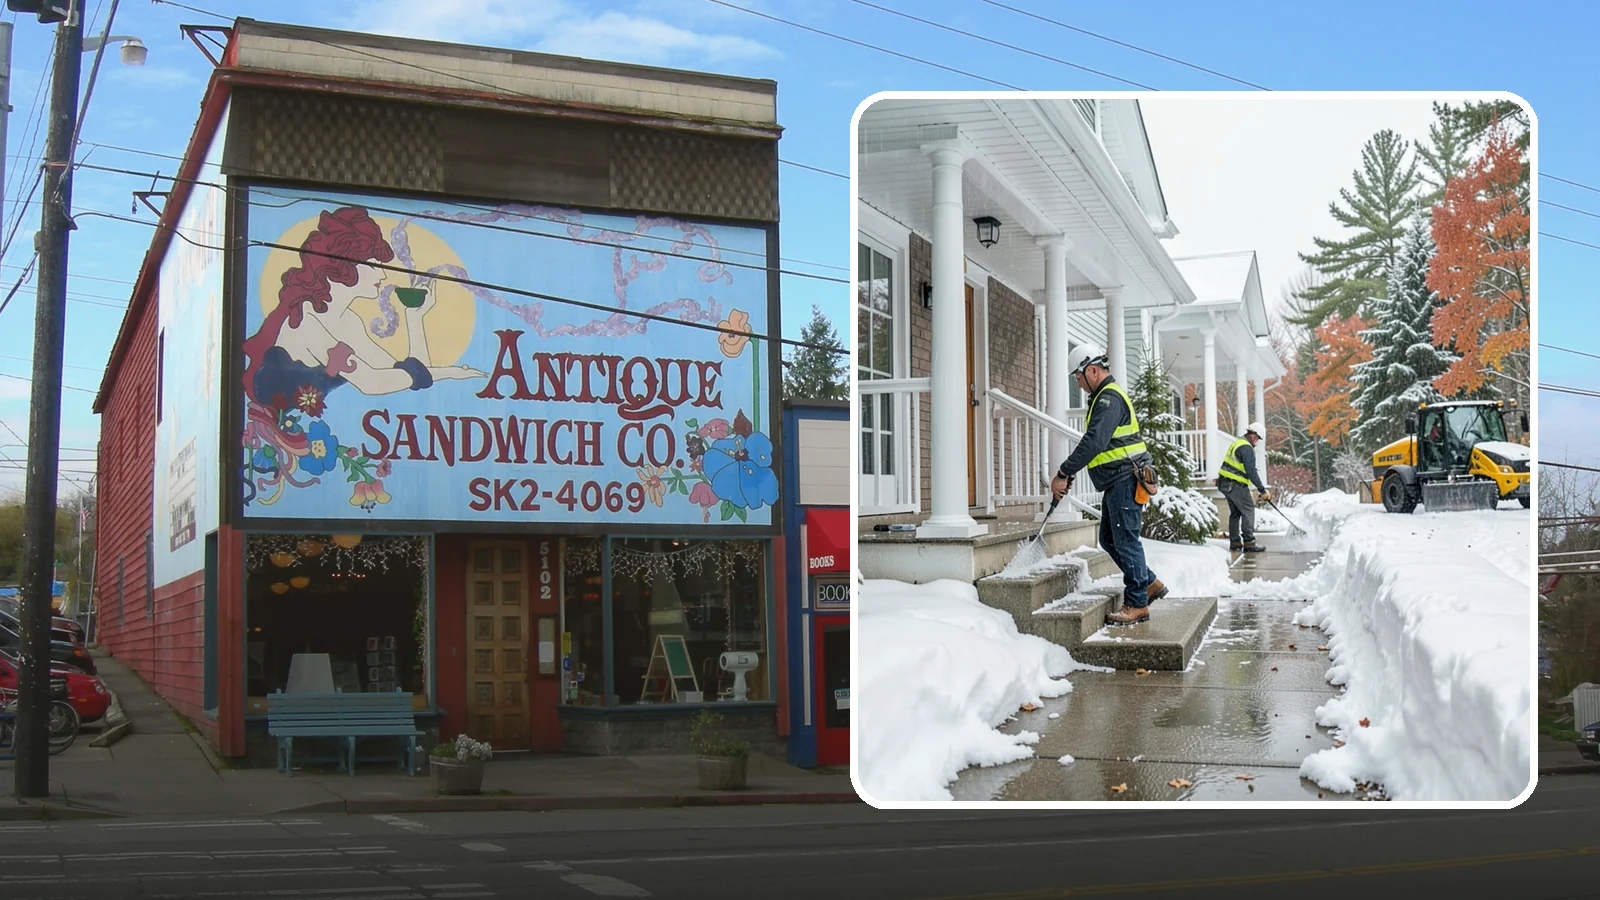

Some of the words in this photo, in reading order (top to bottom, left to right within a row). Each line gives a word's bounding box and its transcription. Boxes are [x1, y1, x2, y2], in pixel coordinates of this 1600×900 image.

[476, 329, 723, 420] ANTIQUE
[361, 409, 604, 467] SANDWICH
[617, 422, 685, 469] CO.
[468, 477, 646, 512] SK2-4069
[539, 542, 551, 599] 5102
[809, 555, 835, 569] BOOKS
